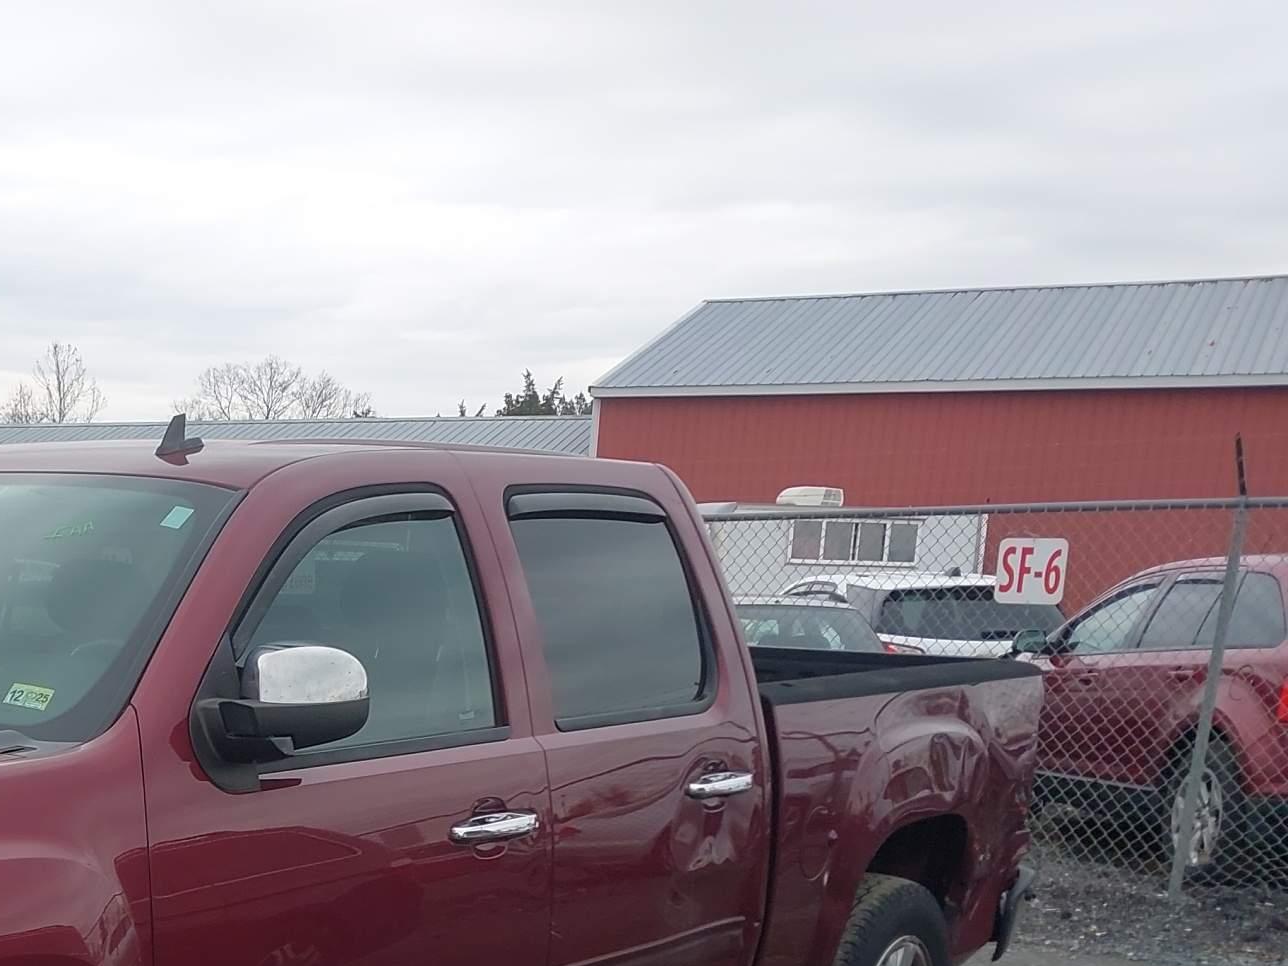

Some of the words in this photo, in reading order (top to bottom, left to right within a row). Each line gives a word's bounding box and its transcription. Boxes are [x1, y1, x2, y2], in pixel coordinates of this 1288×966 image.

[998, 545, 1062, 595] SF-6
[8, 689, 24, 703] 12
[36, 693, 50, 704] 25
